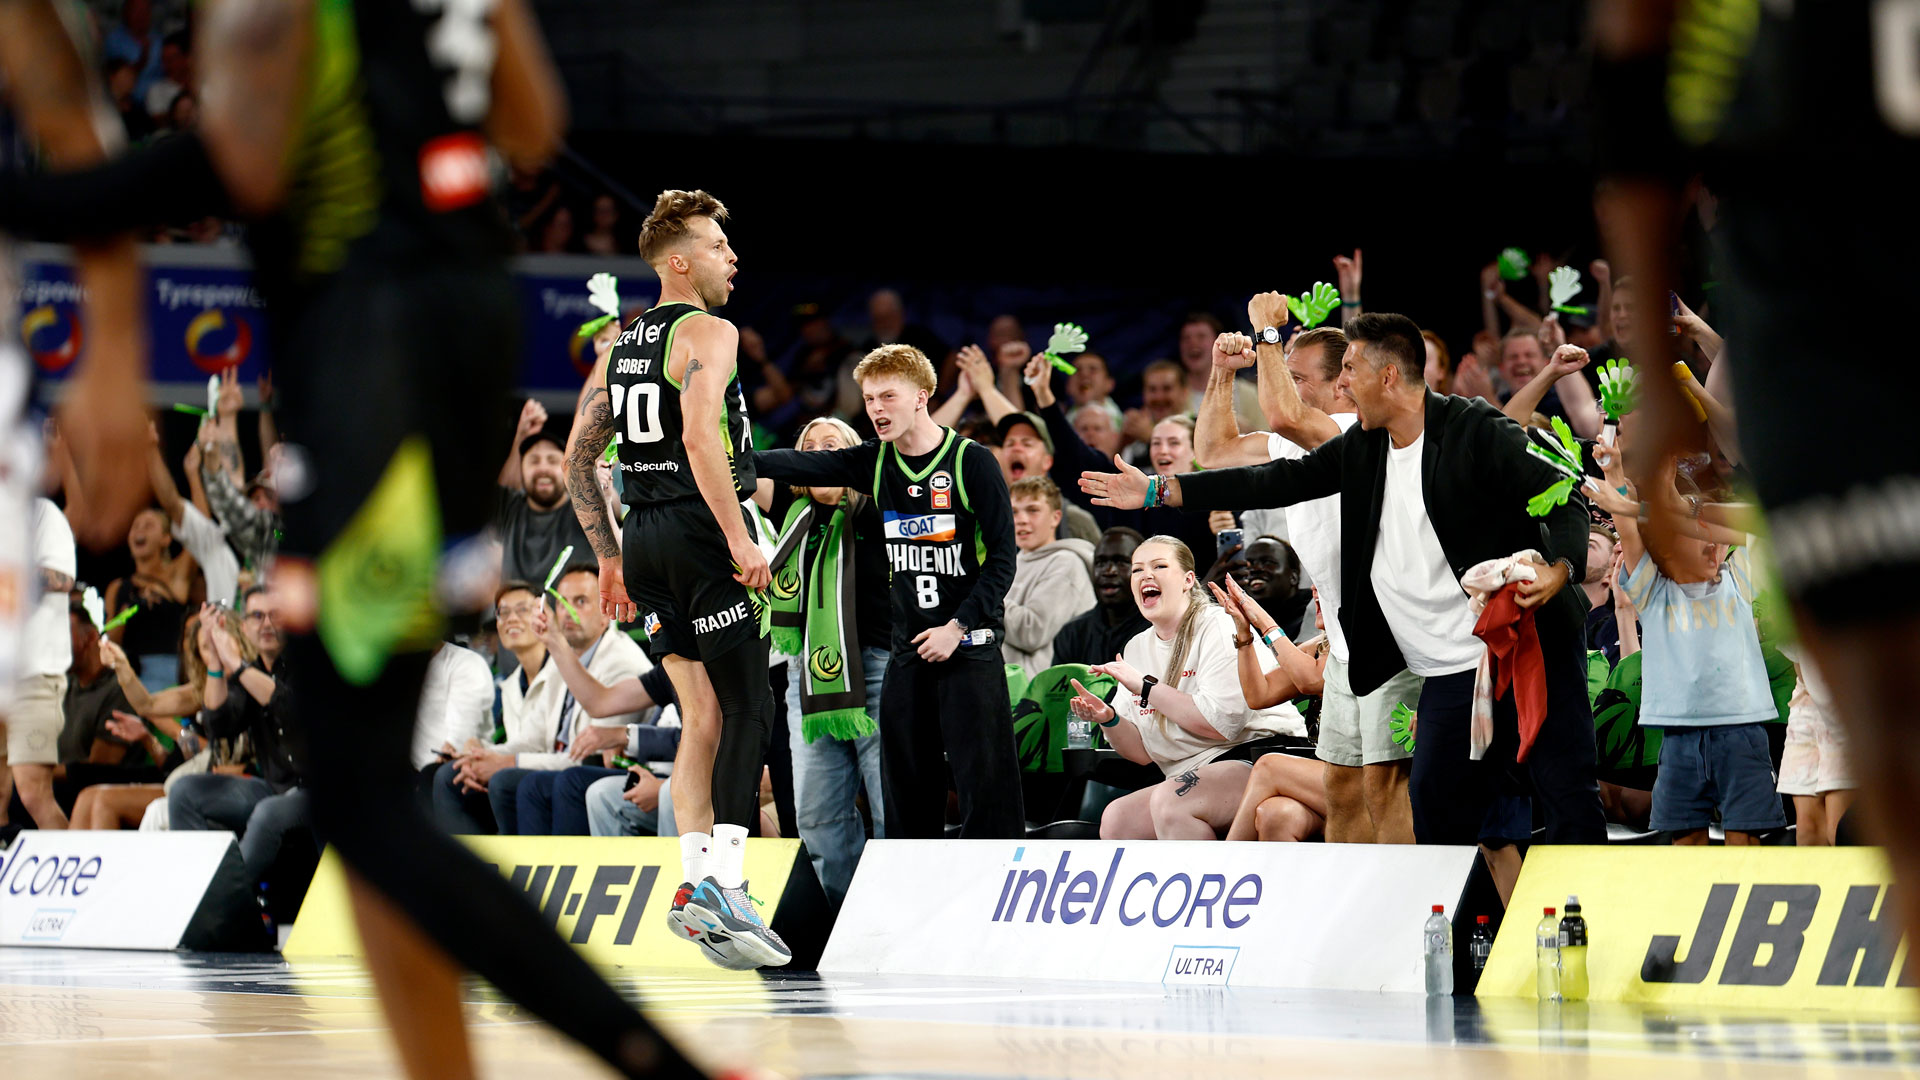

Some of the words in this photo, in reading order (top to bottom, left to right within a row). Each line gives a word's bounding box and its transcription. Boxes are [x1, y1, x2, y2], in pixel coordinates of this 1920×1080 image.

[616, 358, 652, 375] SOBEY
[634, 460, 679, 472] Security
[899, 516, 936, 537] GOAT
[916, 575, 940, 609] 8
[692, 601, 749, 635] TRADIE
[992, 847, 1126, 925] intel
[1640, 883, 1822, 986] JB
[1174, 957, 1225, 977] ULTRA
